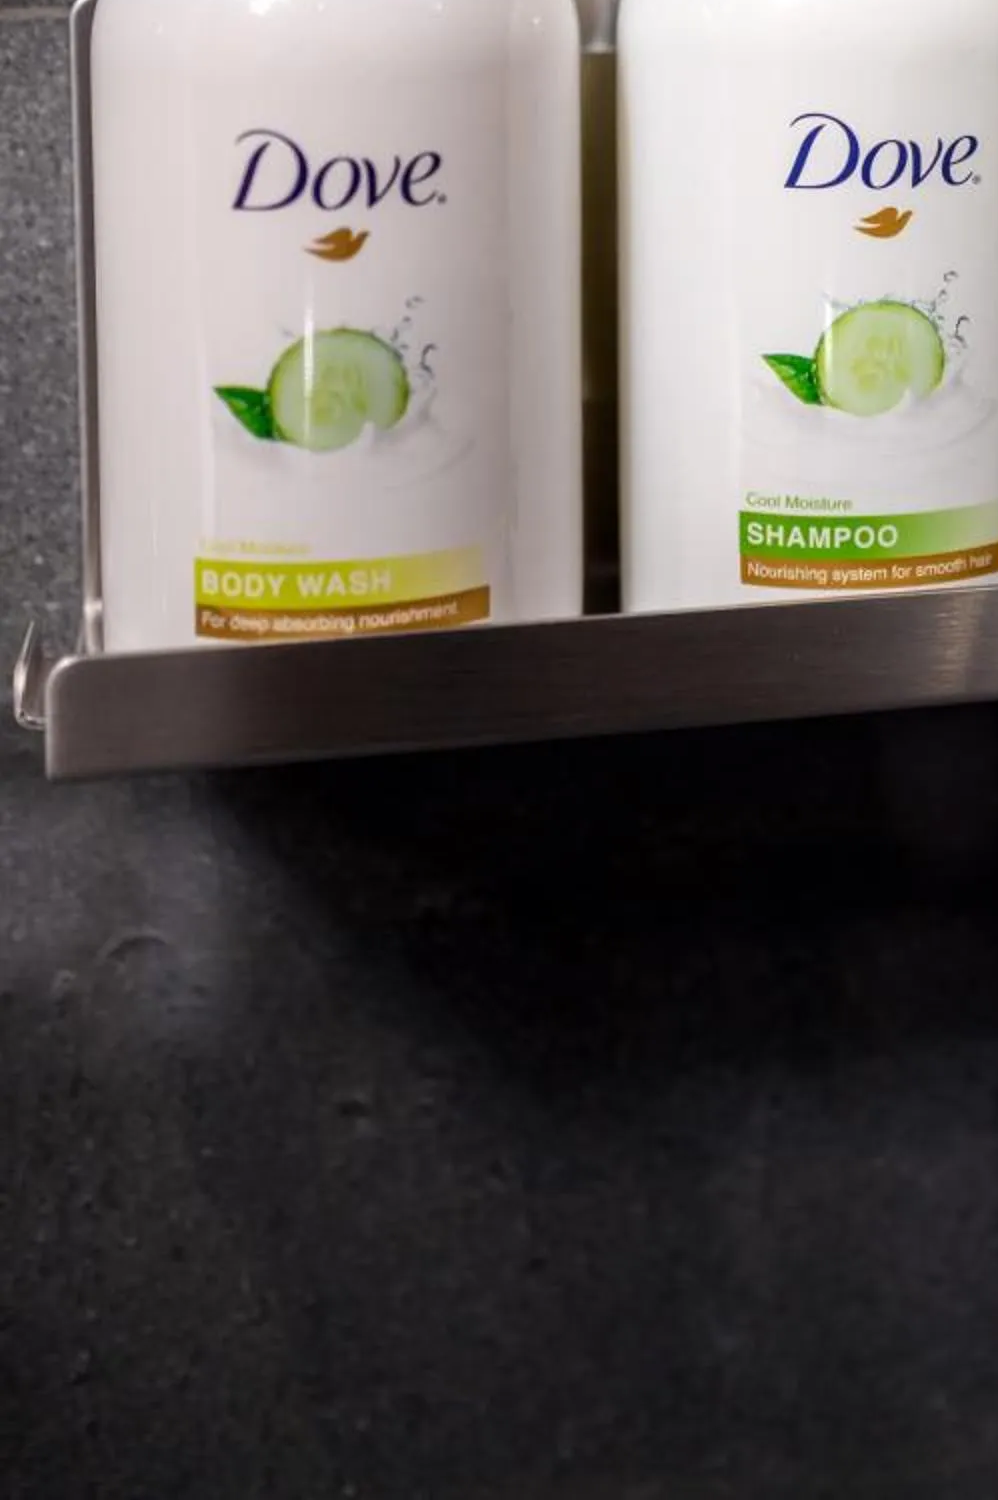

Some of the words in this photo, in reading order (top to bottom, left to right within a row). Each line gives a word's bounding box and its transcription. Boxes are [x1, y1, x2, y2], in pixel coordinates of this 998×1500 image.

[783, 112, 979, 190] Dove
[232, 127, 442, 212] Dove
[746, 492, 781, 508] Cool
[785, 495, 853, 511] Moisture
[747, 521, 898, 549] SHAMPOO
[747, 563, 827, 584] Nourishing
[832, 567, 888, 584] system
[891, 564, 913, 580] for
[915, 558, 967, 577] smooth
[969, 552, 993, 568] hair
[201, 569, 287, 597] BODY
[297, 569, 392, 597] WASH
[202, 610, 226, 629] For
[230, 615, 269, 636] deep
[273, 611, 354, 634] absorbing
